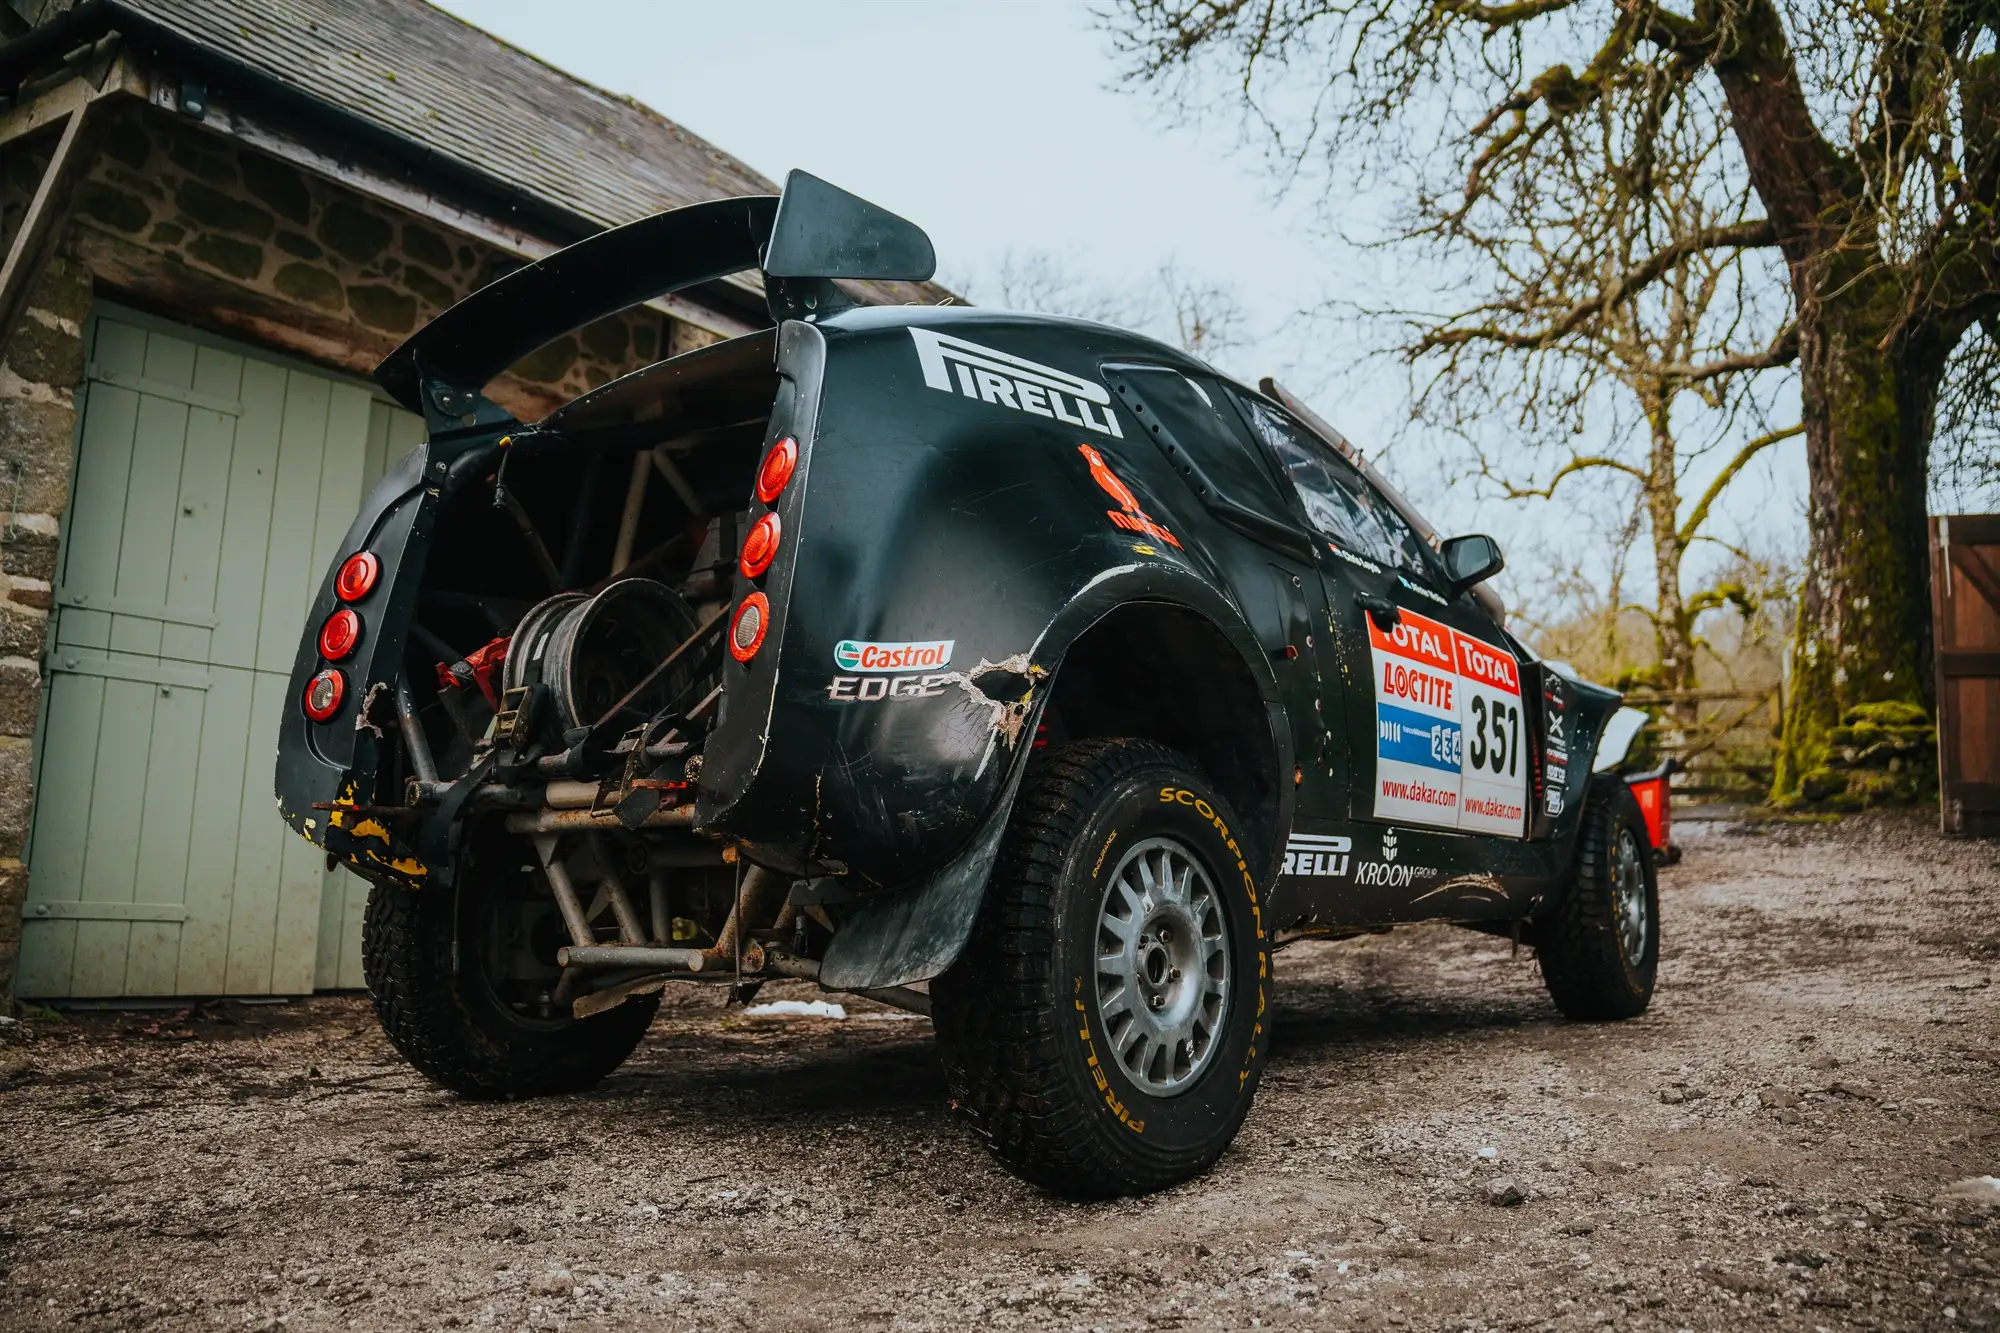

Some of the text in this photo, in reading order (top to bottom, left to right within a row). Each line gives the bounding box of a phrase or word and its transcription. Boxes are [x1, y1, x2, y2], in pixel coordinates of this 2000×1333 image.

[907, 326, 1124, 439] PIRELLI
[861, 644, 945, 669] Castrol
[1383, 621, 1449, 662] OTAL
[1459, 639, 1516, 688] TOTAL
[824, 675, 951, 700] EDGE
[1383, 661, 1453, 711] LOCTITE
[1470, 694, 1518, 778] 351
[1383, 779, 1457, 808] www.dakar.com
[1465, 796, 1522, 821] www.dakar.com
[1160, 787, 1264, 940] SCORPION
[1355, 861, 1438, 887] KROON GROUP
[1075, 1000, 1145, 1134] PIRELLI
